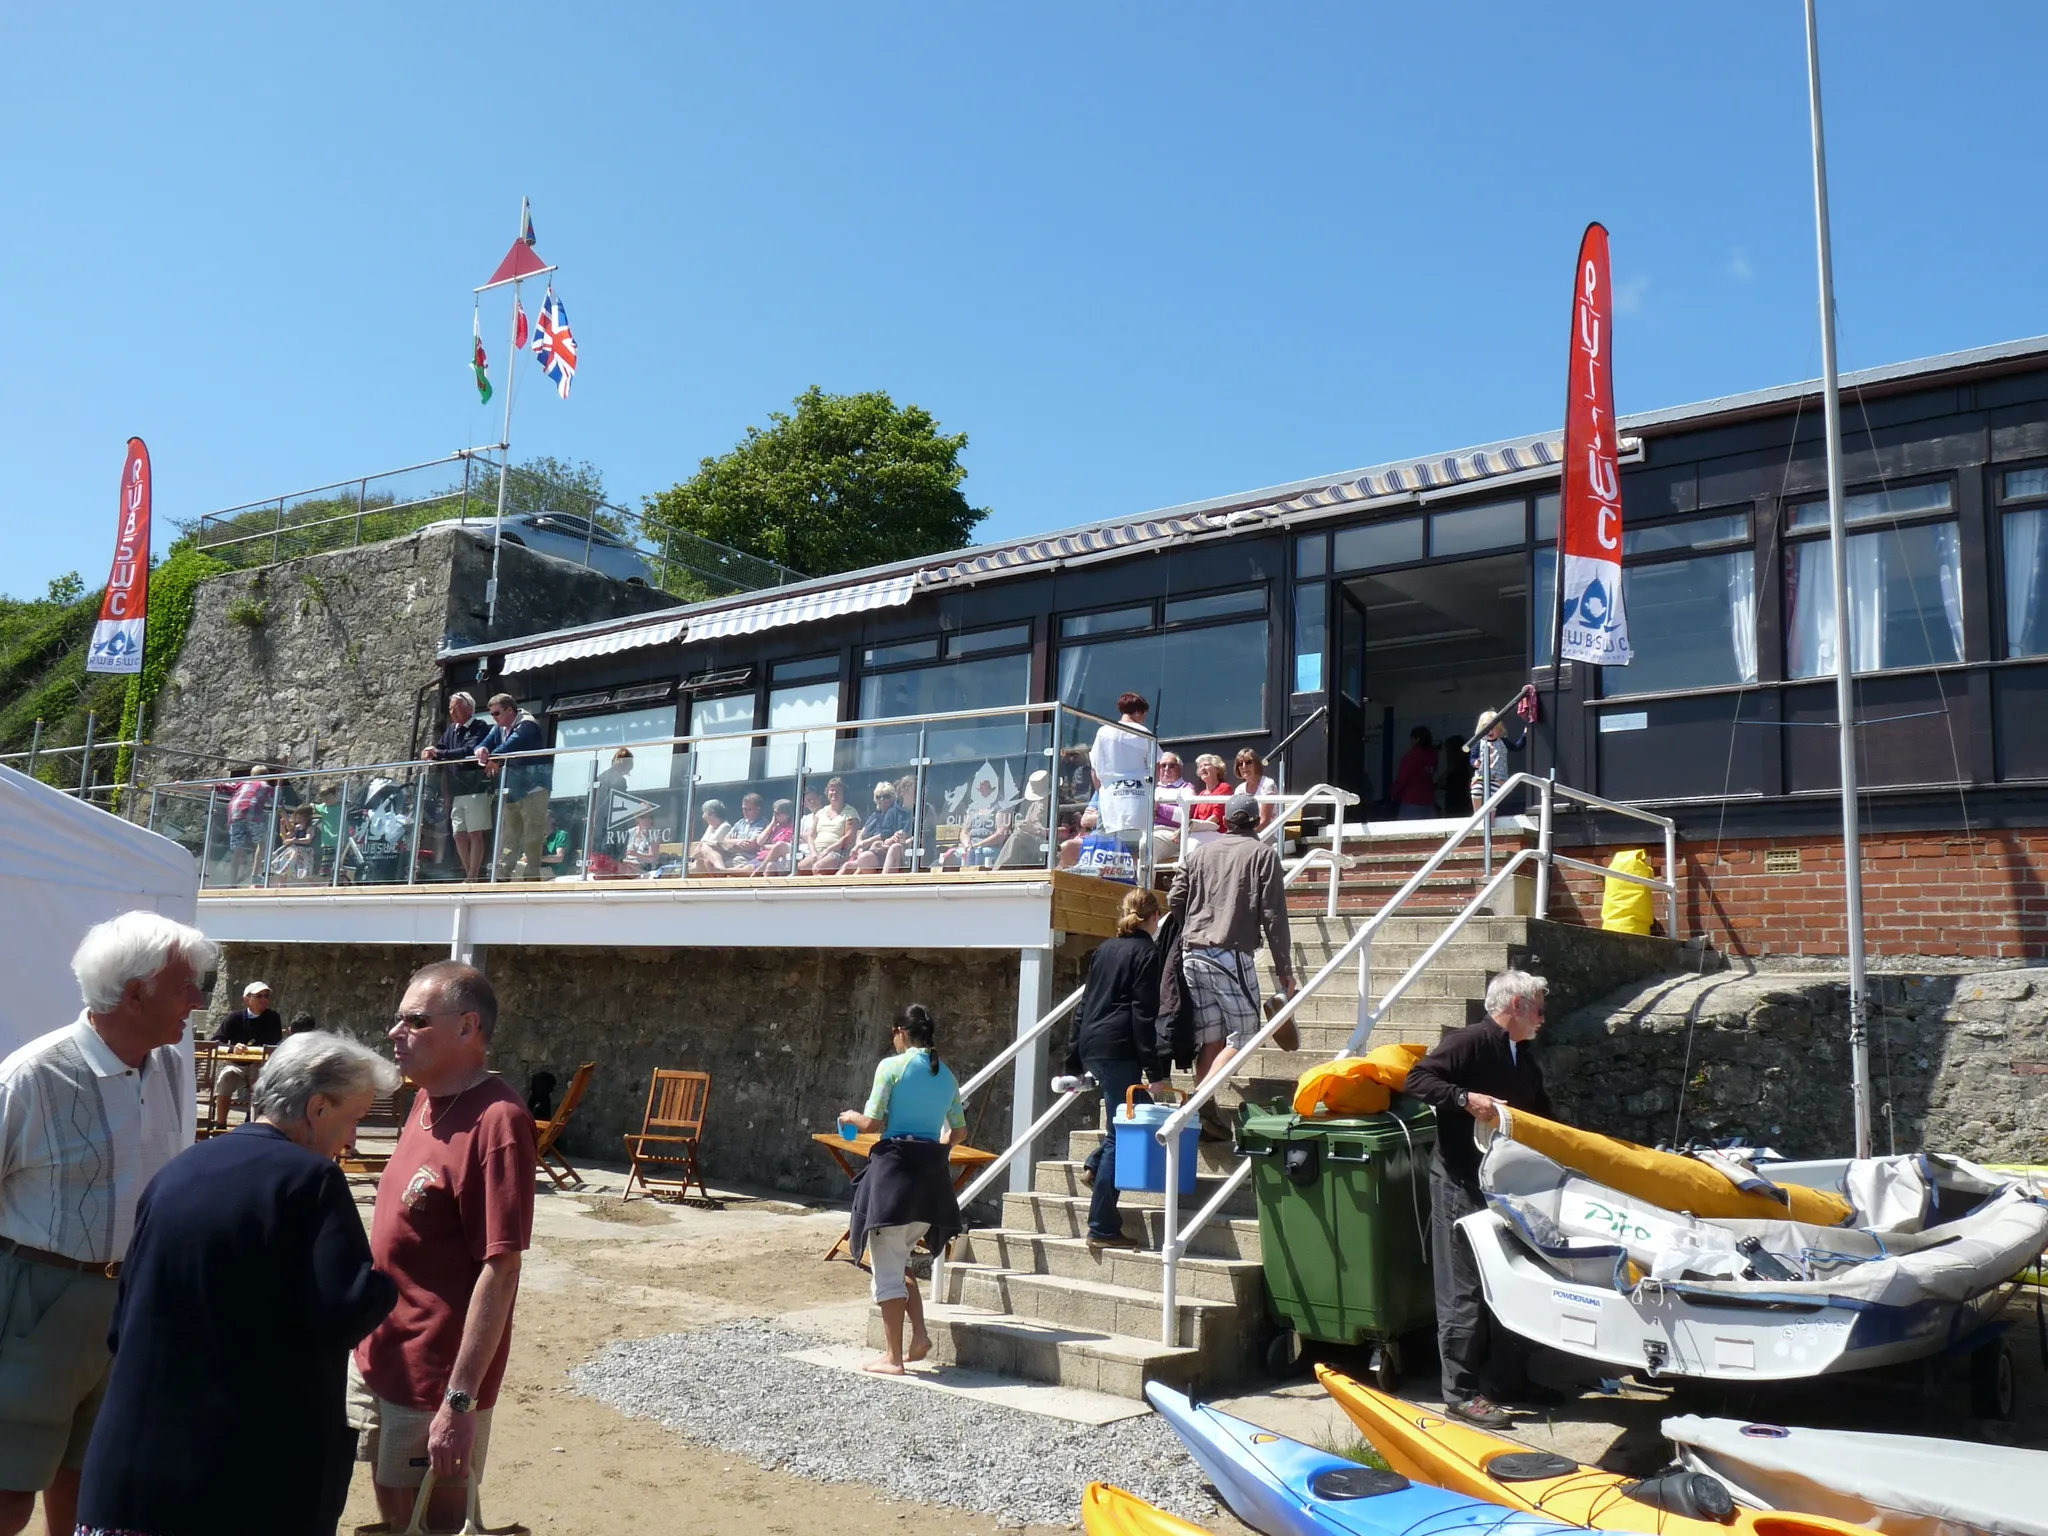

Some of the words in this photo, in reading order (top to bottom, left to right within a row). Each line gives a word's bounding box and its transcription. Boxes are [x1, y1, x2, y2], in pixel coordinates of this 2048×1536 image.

[109, 458, 143, 616] RWBSWC
[606, 828, 671, 845] RWSWC
[1095, 852, 1132, 867] SPORTS
